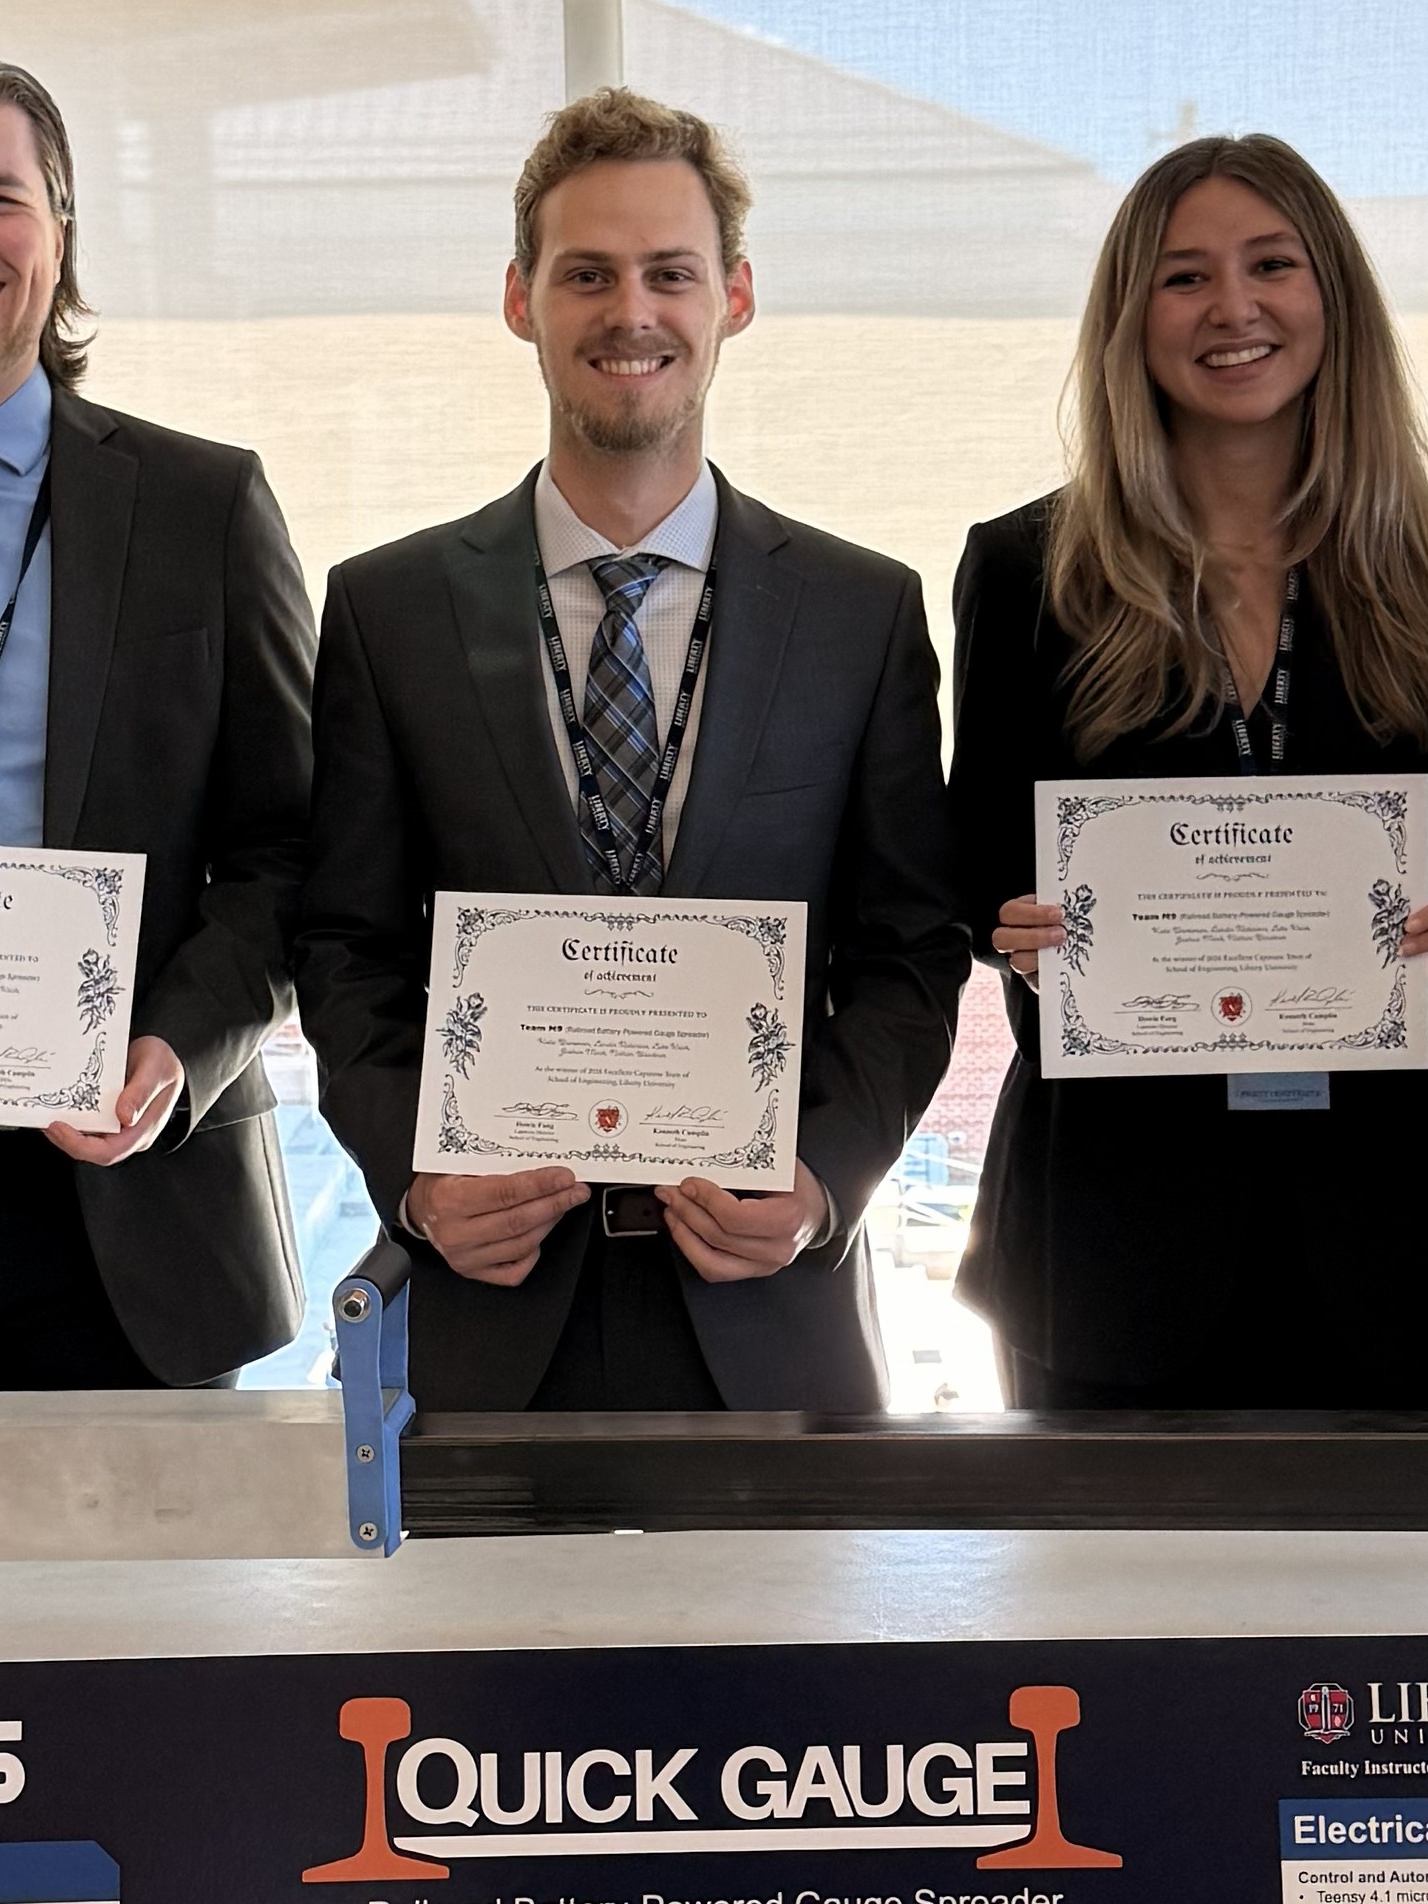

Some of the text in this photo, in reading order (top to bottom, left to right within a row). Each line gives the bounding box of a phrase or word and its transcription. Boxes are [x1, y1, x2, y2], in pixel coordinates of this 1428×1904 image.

[1169, 822, 1293, 846] Certificate
[562, 938, 677, 965] Certificate
[1301, 1760, 1359, 1778] Faculty
[396, 1738, 1031, 1828] QUICK GAUGE
[1298, 1870, 1353, 1884] Control
[1358, 1870, 1385, 1883] and
